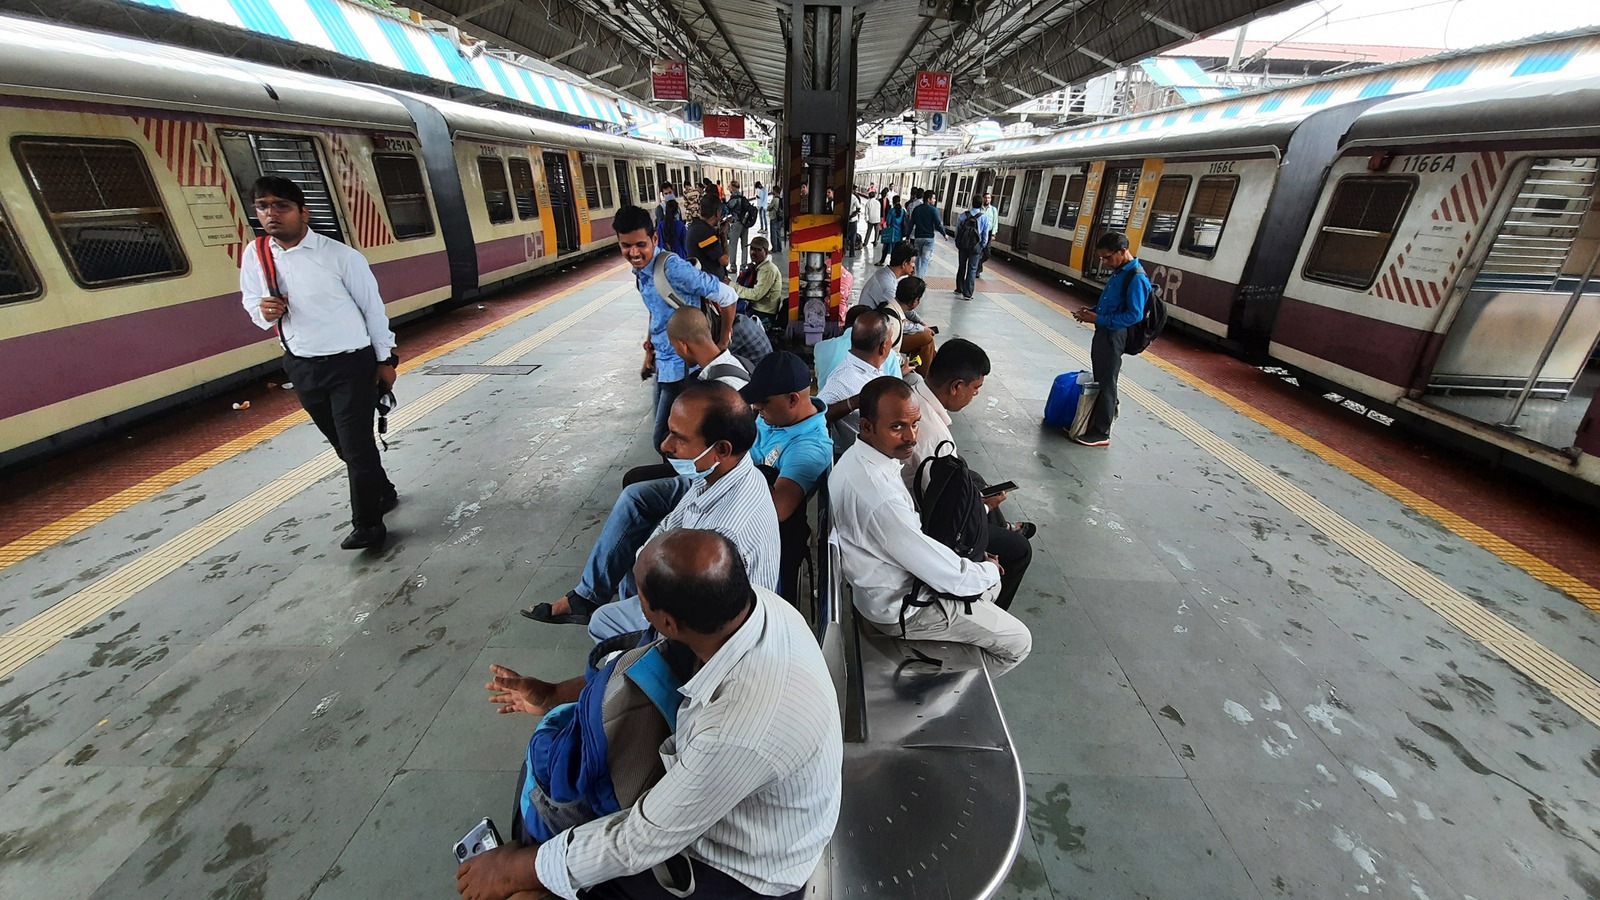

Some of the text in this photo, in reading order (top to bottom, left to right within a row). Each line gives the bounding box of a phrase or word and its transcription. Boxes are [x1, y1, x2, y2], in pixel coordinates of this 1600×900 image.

[684, 102, 702, 121] 10
[932, 112, 943, 131] 9
[384, 138, 415, 152] 2251A
[1209, 161, 1236, 174] 1166C
[1401, 154, 1456, 173] 1166A
